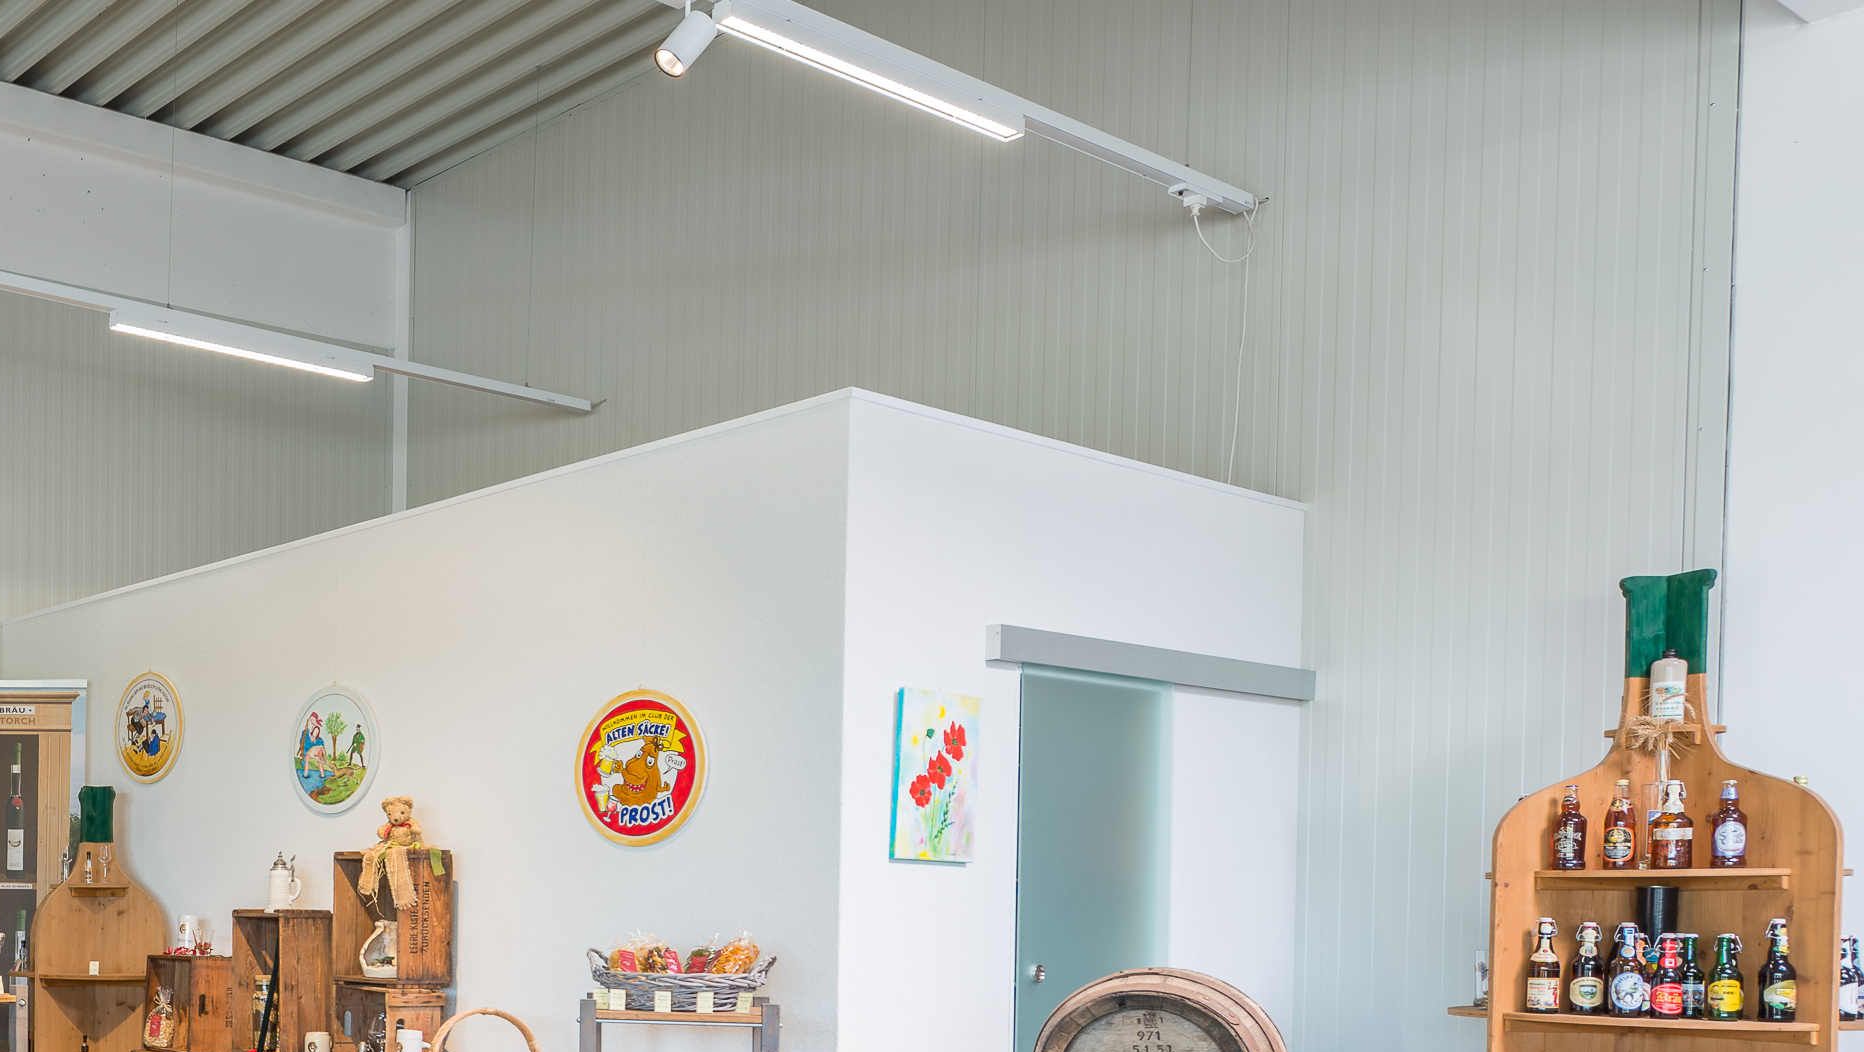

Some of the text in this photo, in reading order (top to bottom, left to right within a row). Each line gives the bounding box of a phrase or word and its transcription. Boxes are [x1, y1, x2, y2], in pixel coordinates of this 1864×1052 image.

[606, 720, 670, 744] ALTEN SÄCKE!
[620, 796, 673, 824] PROST!
[1137, 1030, 1161, 1041] 971
